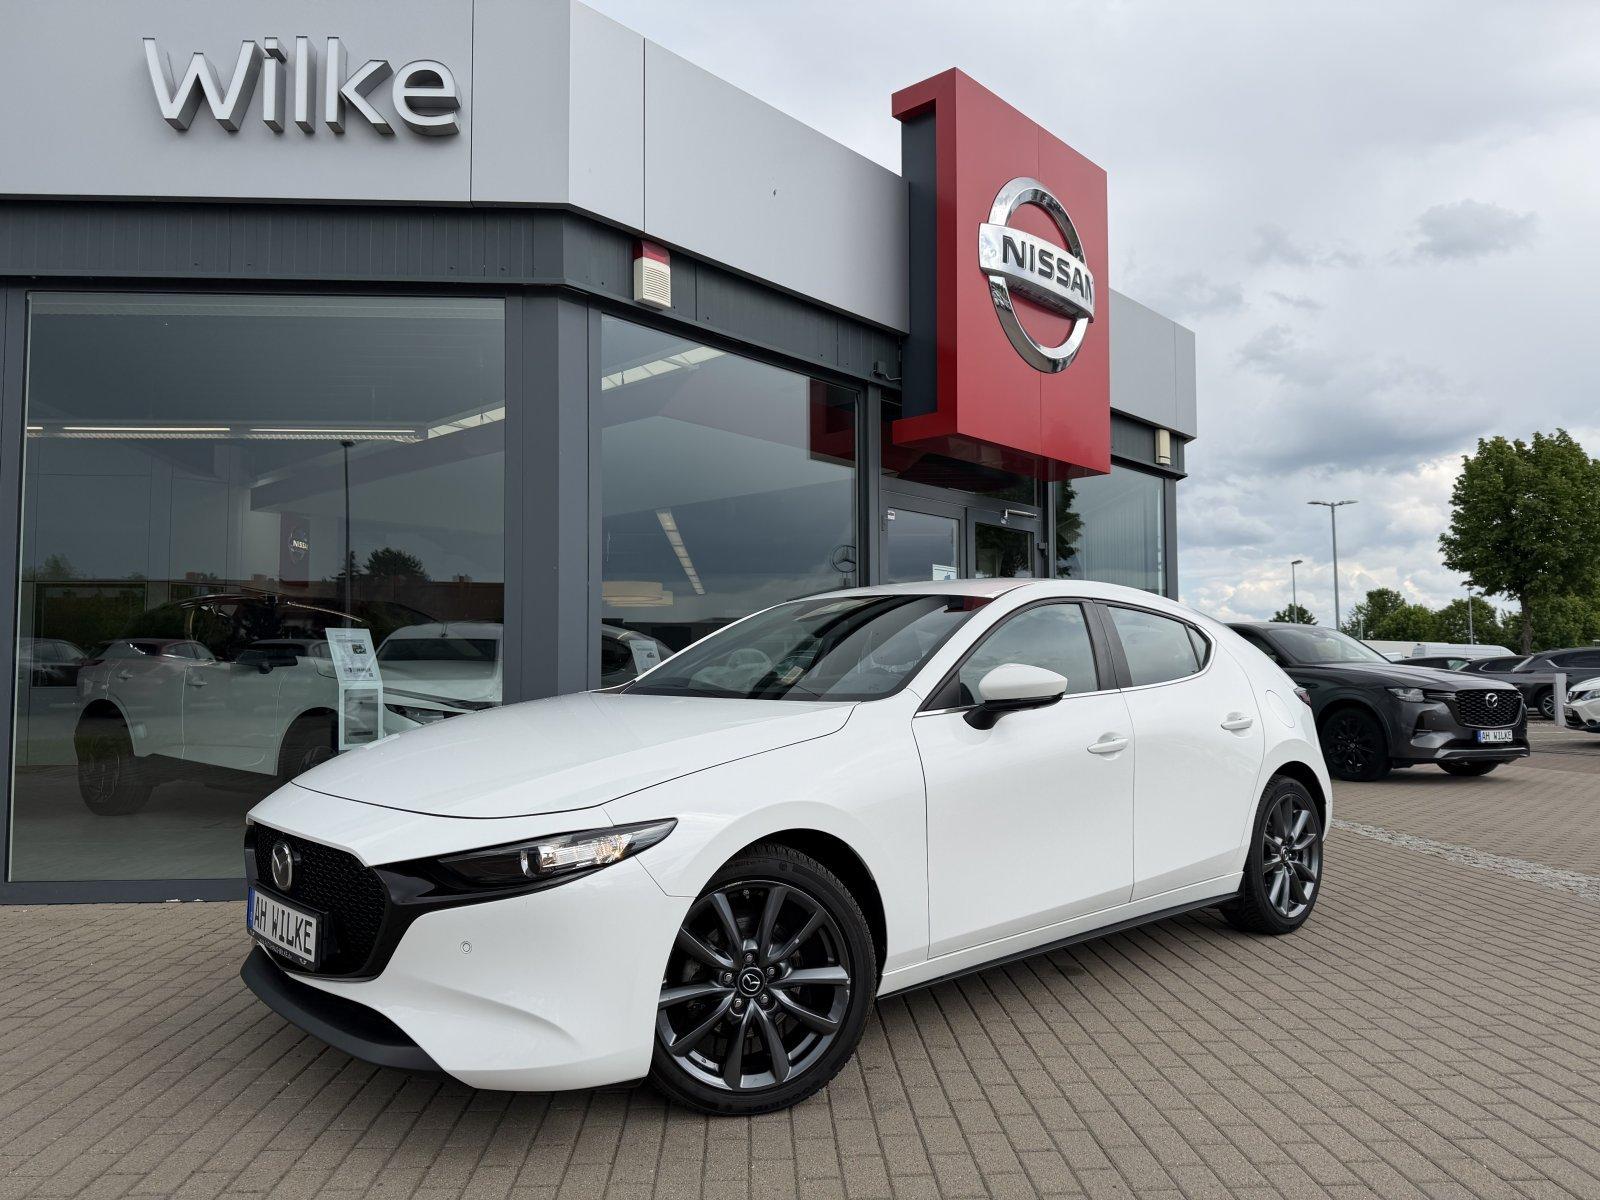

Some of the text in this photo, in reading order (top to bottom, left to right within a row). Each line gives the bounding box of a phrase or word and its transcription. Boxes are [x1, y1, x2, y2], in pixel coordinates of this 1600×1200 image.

[142, 35, 461, 136] Wilke
[1002, 235, 1093, 305] NISSAN
[1482, 731, 1512, 741] AH WILKE
[254, 896, 267, 932] AH
[272, 905, 313, 955] WILKE
